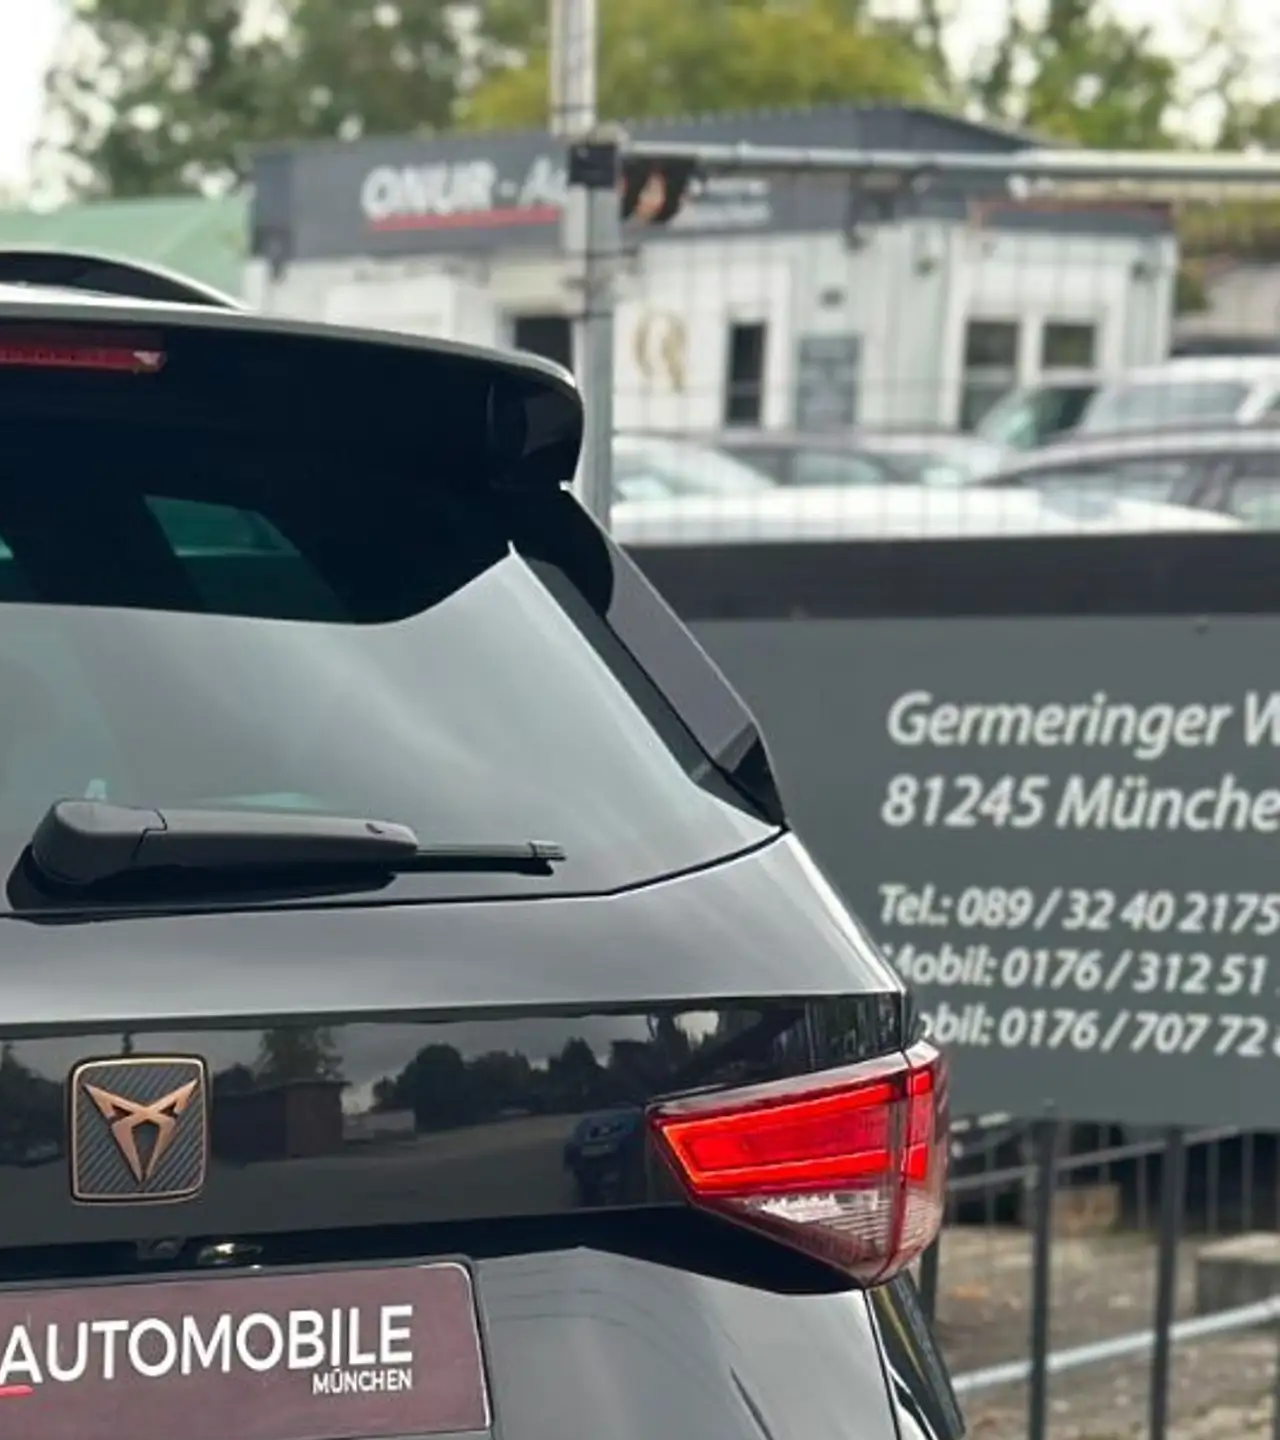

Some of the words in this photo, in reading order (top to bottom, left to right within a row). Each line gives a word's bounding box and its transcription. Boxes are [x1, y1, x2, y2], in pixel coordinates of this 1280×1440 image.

[886, 690, 1234, 761] Germeringer
[880, 773, 1050, 829] 81245
[1000, 947, 1104, 992] 0176
[997, 1006, 1100, 1051] 0176
[1130, 1010, 1212, 1055] 707
[311, 1367, 414, 1396] MÜNCHEN
